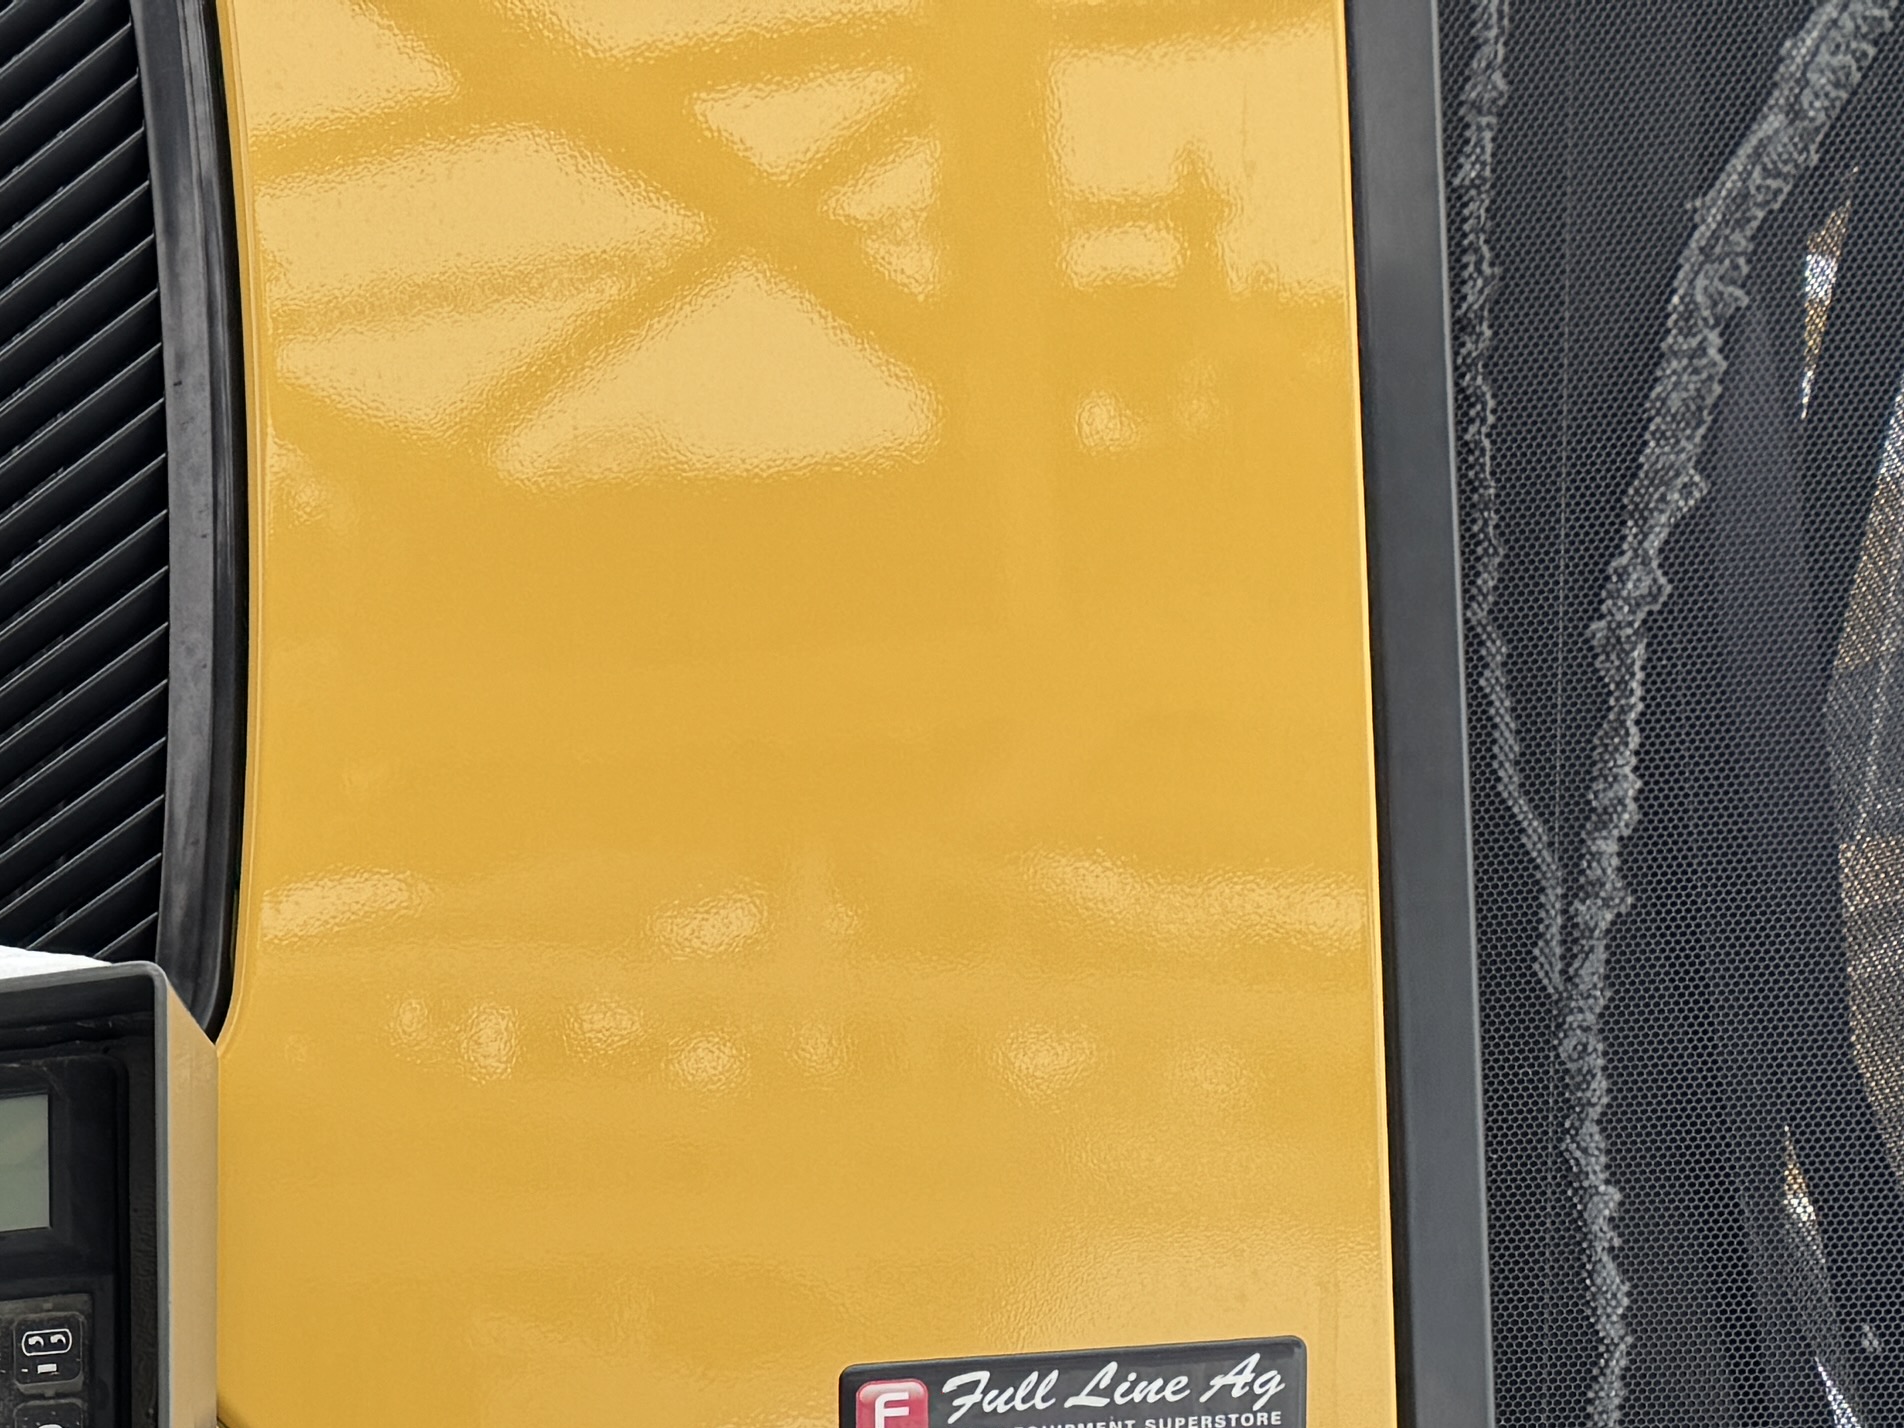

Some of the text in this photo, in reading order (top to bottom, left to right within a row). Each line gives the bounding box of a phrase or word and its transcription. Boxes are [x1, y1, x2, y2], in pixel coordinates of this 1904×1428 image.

[942, 1352, 1286, 1425] Full Line Ag
